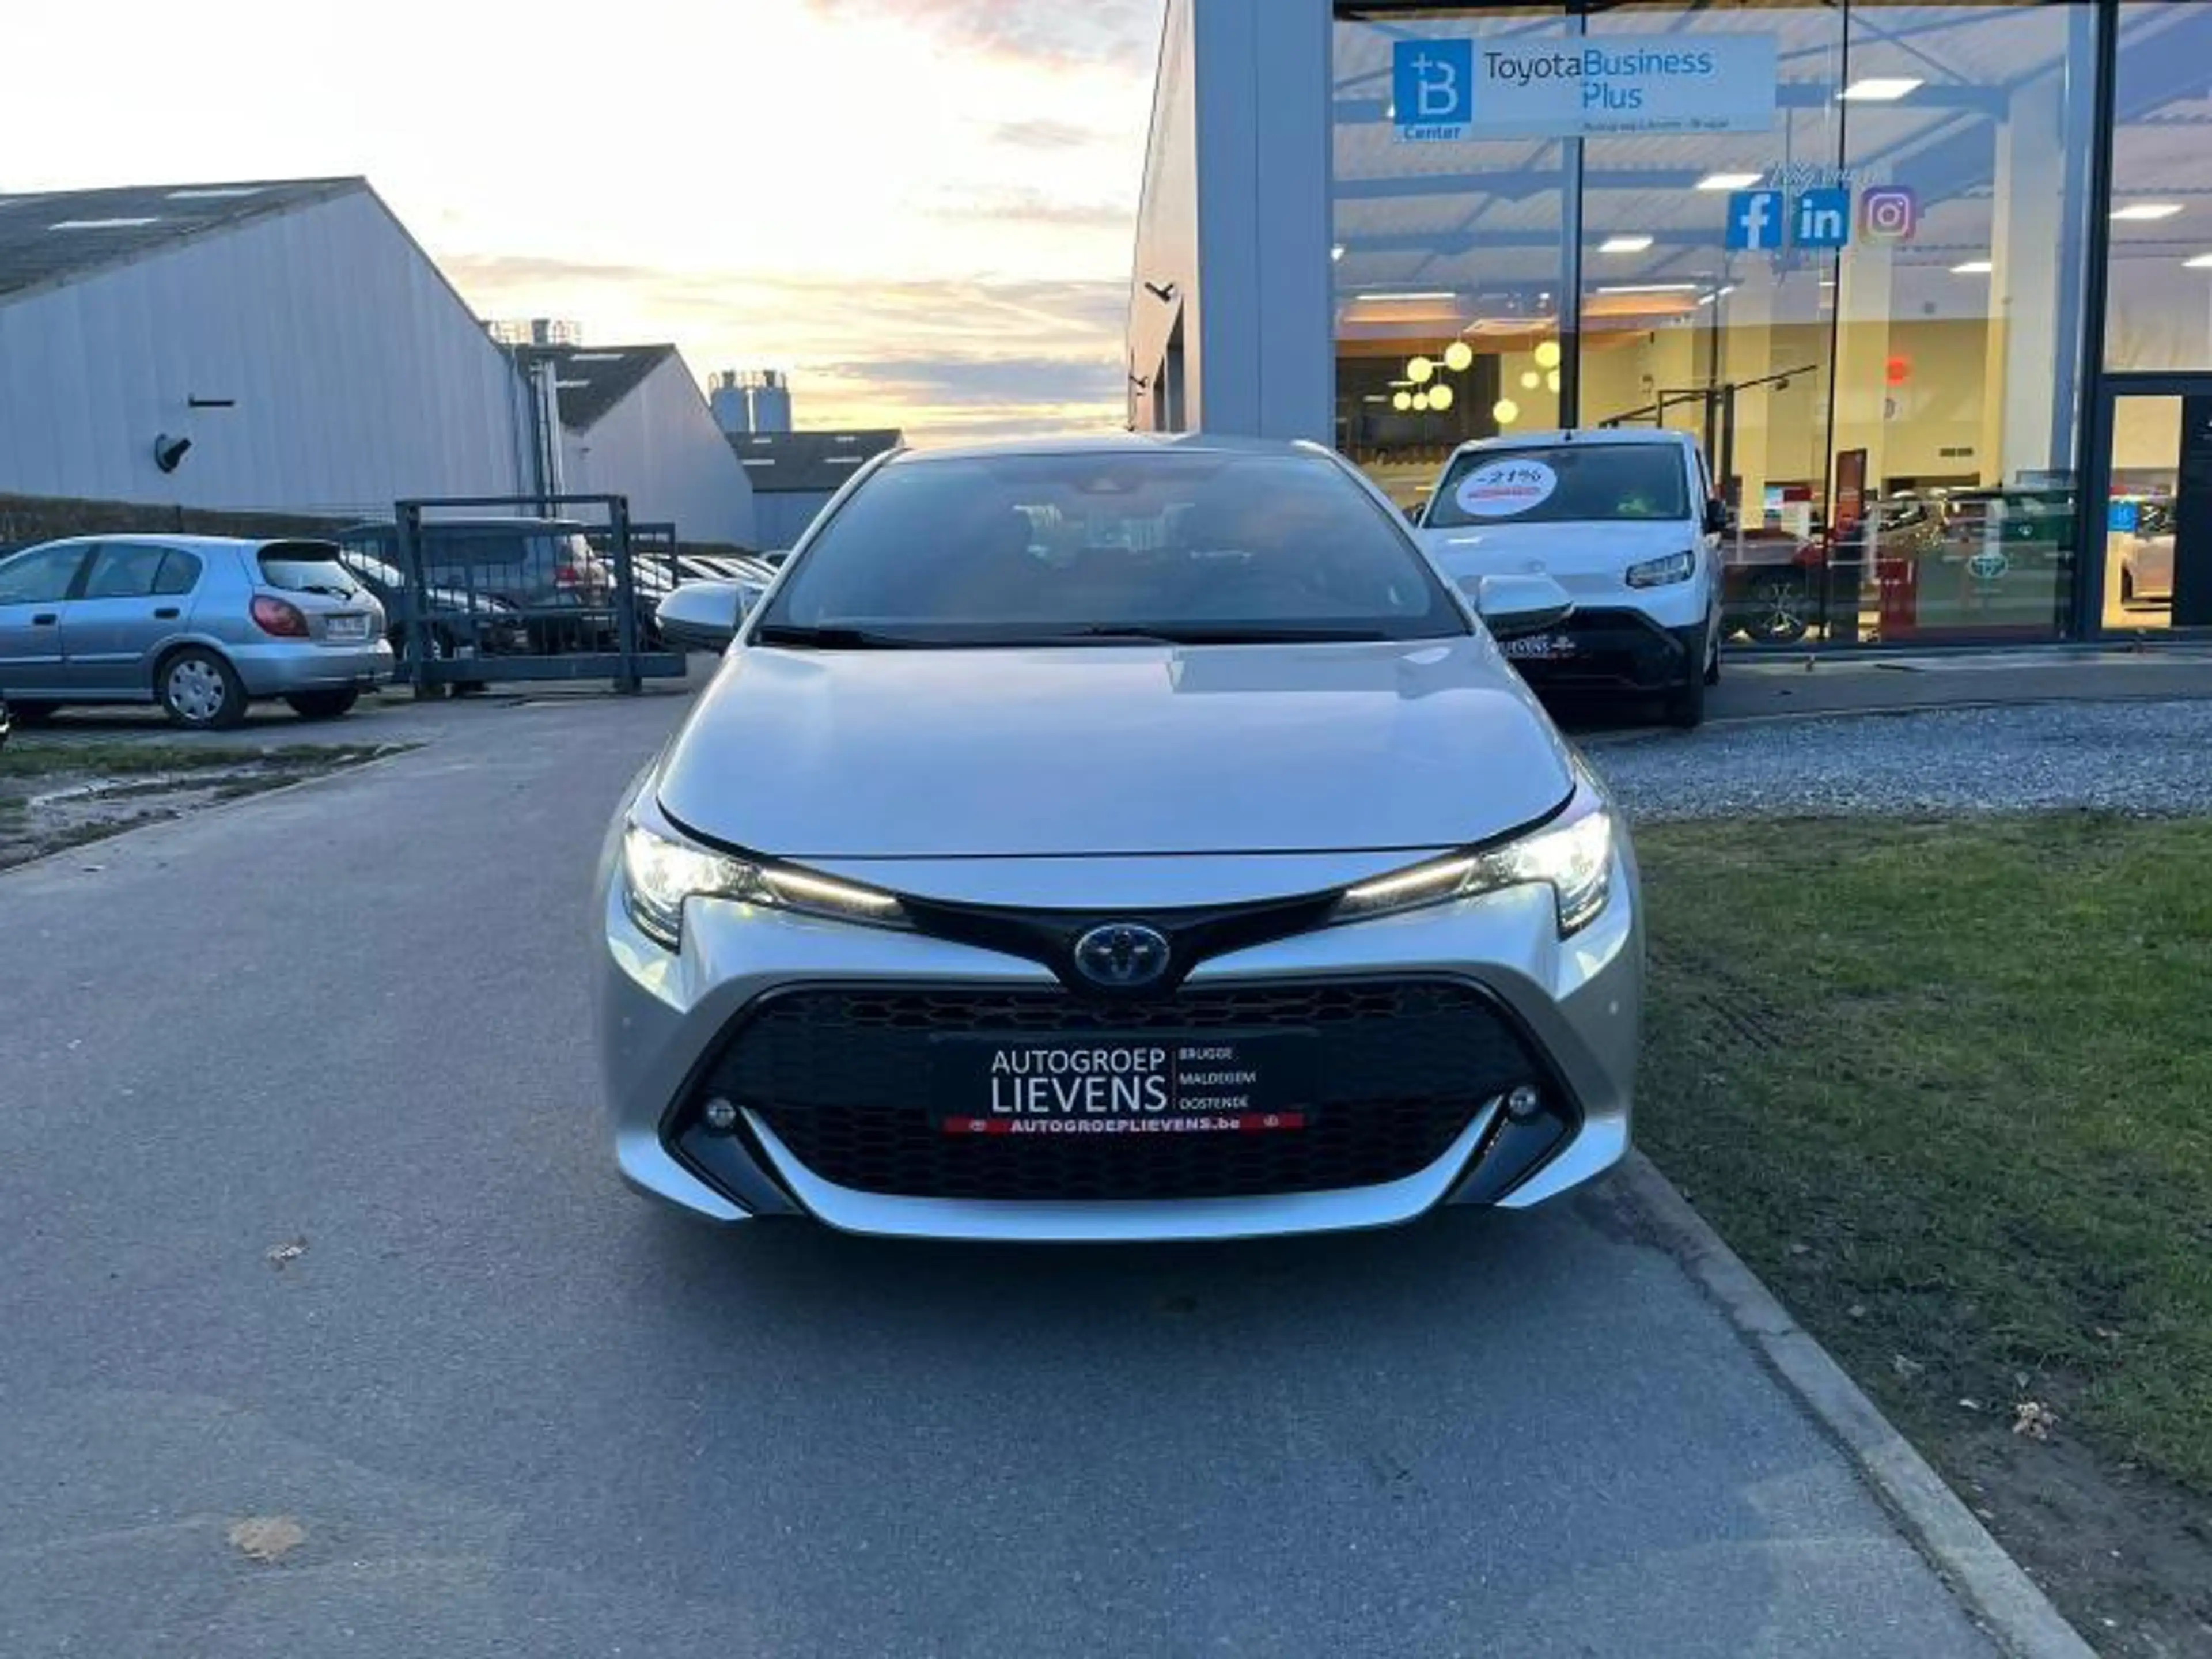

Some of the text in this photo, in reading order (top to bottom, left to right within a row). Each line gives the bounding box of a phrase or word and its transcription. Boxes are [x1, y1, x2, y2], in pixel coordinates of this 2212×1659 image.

[1582, 82, 1642, 109] Plus
[1404, 126, 1461, 139] Center
[991, 1047, 1166, 1074] AUTOGROEP
[992, 1075, 1168, 1113] LIEVENS
[1009, 1116, 1241, 1132] AUTOGROEPLIEVENS.be
